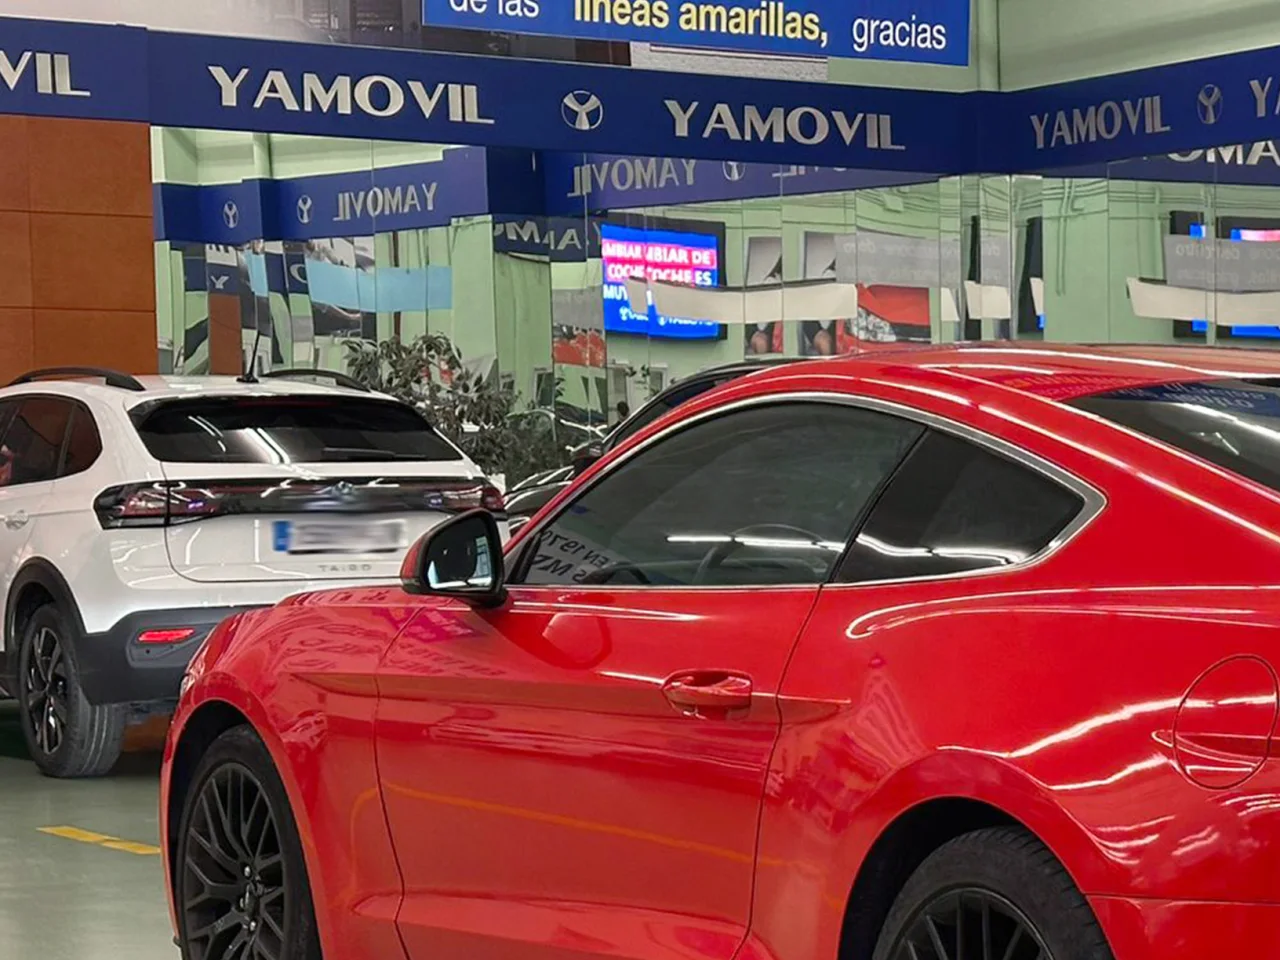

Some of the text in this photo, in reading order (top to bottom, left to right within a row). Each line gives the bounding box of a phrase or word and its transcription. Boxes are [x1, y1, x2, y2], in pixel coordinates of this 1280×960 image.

[679, 0, 828, 48] amarillas,
[853, 15, 947, 52] gracias
[207, 65, 495, 125] YAMOVIL
[664, 99, 906, 150] YAMOVIL
[1029, 95, 1171, 150] YAMOVIL
